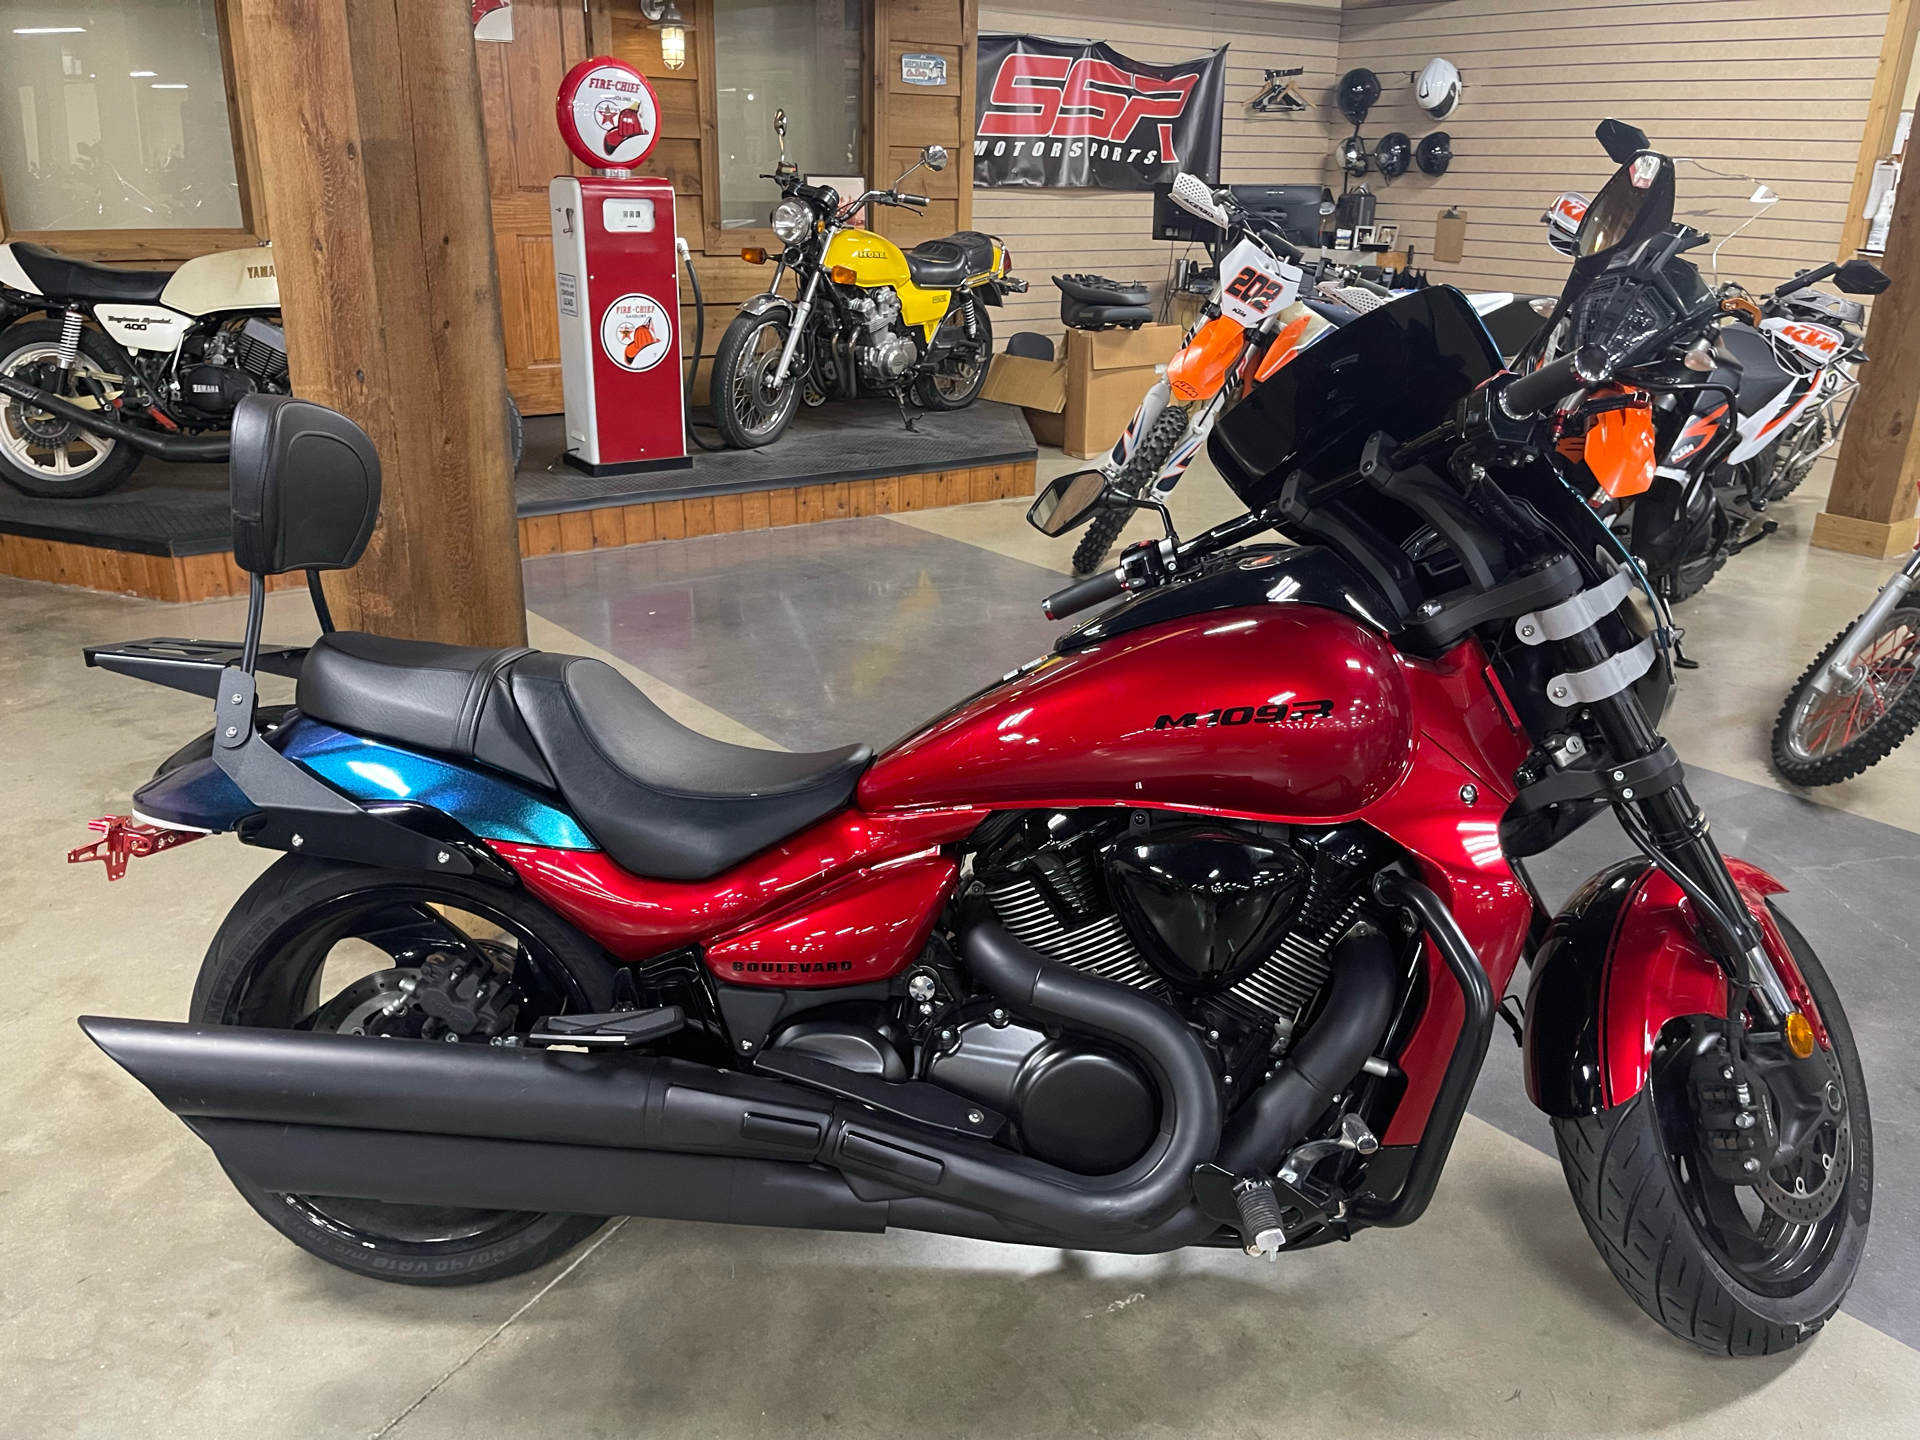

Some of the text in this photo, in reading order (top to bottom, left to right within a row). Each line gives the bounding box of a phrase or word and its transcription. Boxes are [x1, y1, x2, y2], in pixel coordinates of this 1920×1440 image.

[588, 78, 641, 93] FIRE-CHIEF
[977, 53, 1200, 164] SSR
[973, 140, 1158, 165] MOTORSPORTS
[247, 265, 276, 278] YAMA
[1224, 265, 1284, 314] 202
[1232, 307, 1247, 317] KTM
[124, 323, 147, 331] 400
[1781, 325, 1838, 354] KTM
[192, 384, 219, 393] YAMAHA
[1172, 380, 1198, 398] KTM
[1155, 700, 1334, 729] M109R
[732, 961, 853, 973] BOULEVARD
